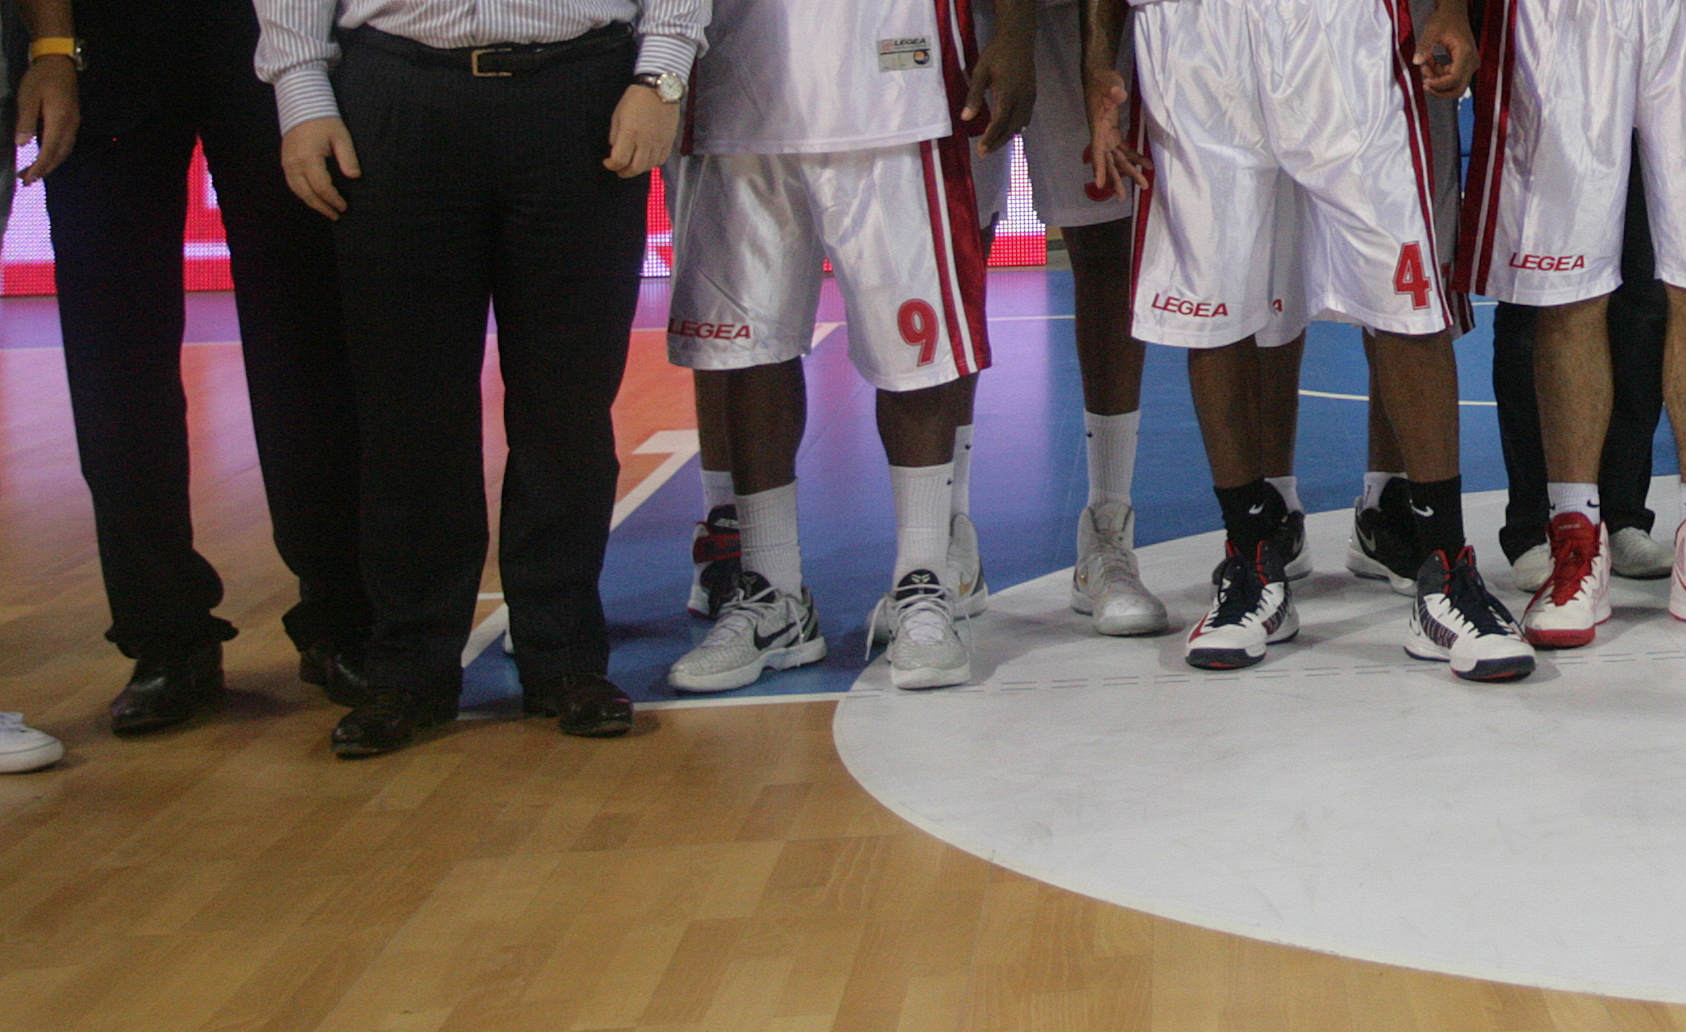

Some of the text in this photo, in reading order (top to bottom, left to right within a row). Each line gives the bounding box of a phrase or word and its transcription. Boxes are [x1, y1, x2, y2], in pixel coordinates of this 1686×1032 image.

[894, 37, 927, 47] LEGEA
[1509, 253, 1585, 271] LEGEA
[1393, 241, 1431, 311] 4
[1151, 293, 1229, 318] LEGEA
[668, 319, 751, 341] LEGEA
[897, 298, 939, 367] 9
